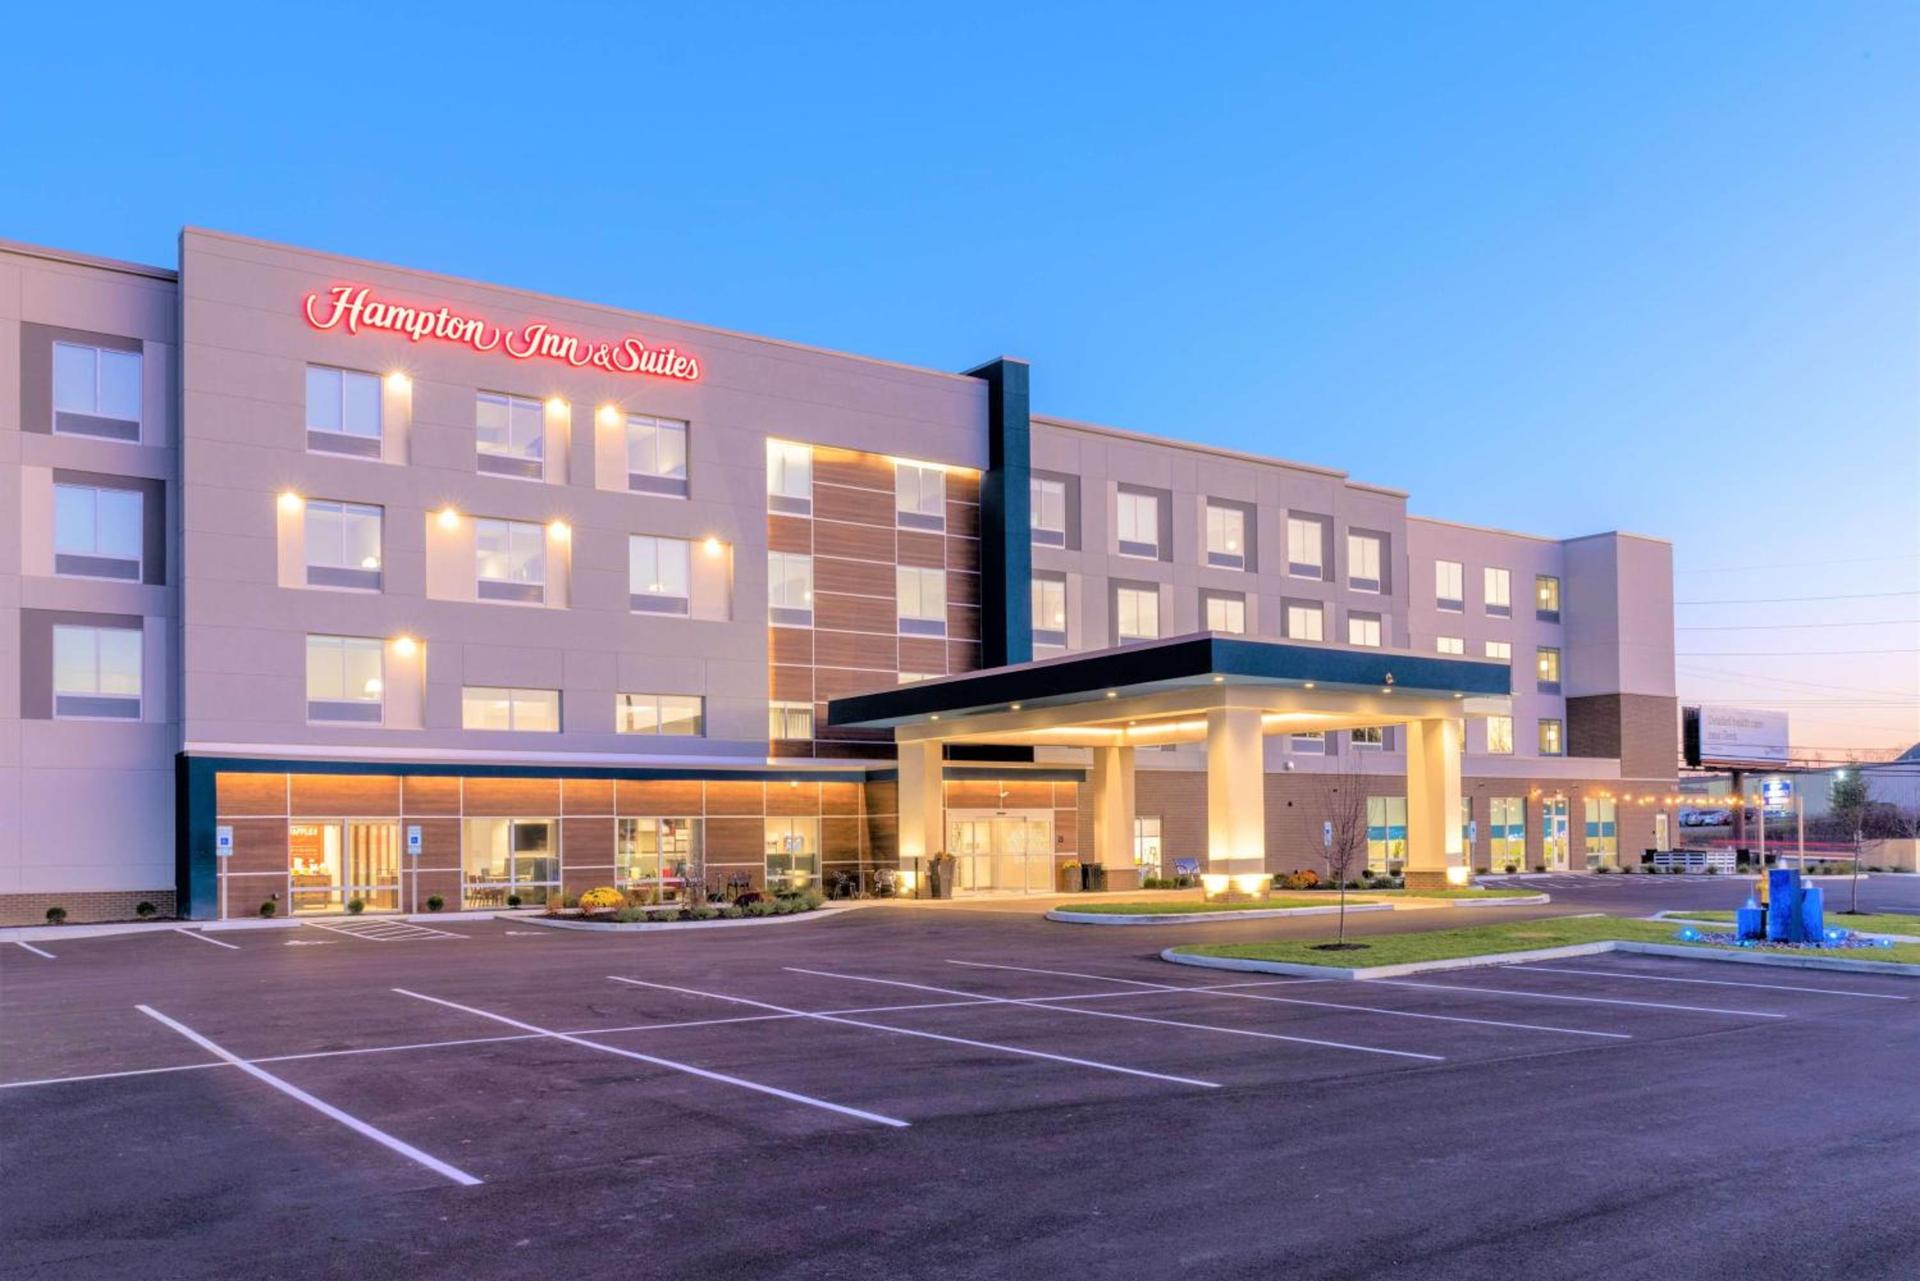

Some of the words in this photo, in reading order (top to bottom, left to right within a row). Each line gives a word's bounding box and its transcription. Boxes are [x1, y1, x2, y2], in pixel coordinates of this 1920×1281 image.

[305, 286, 501, 351] Hampton
[504, 324, 593, 367] Inn
[593, 343, 614, 372] &
[612, 338, 700, 381] Suites
